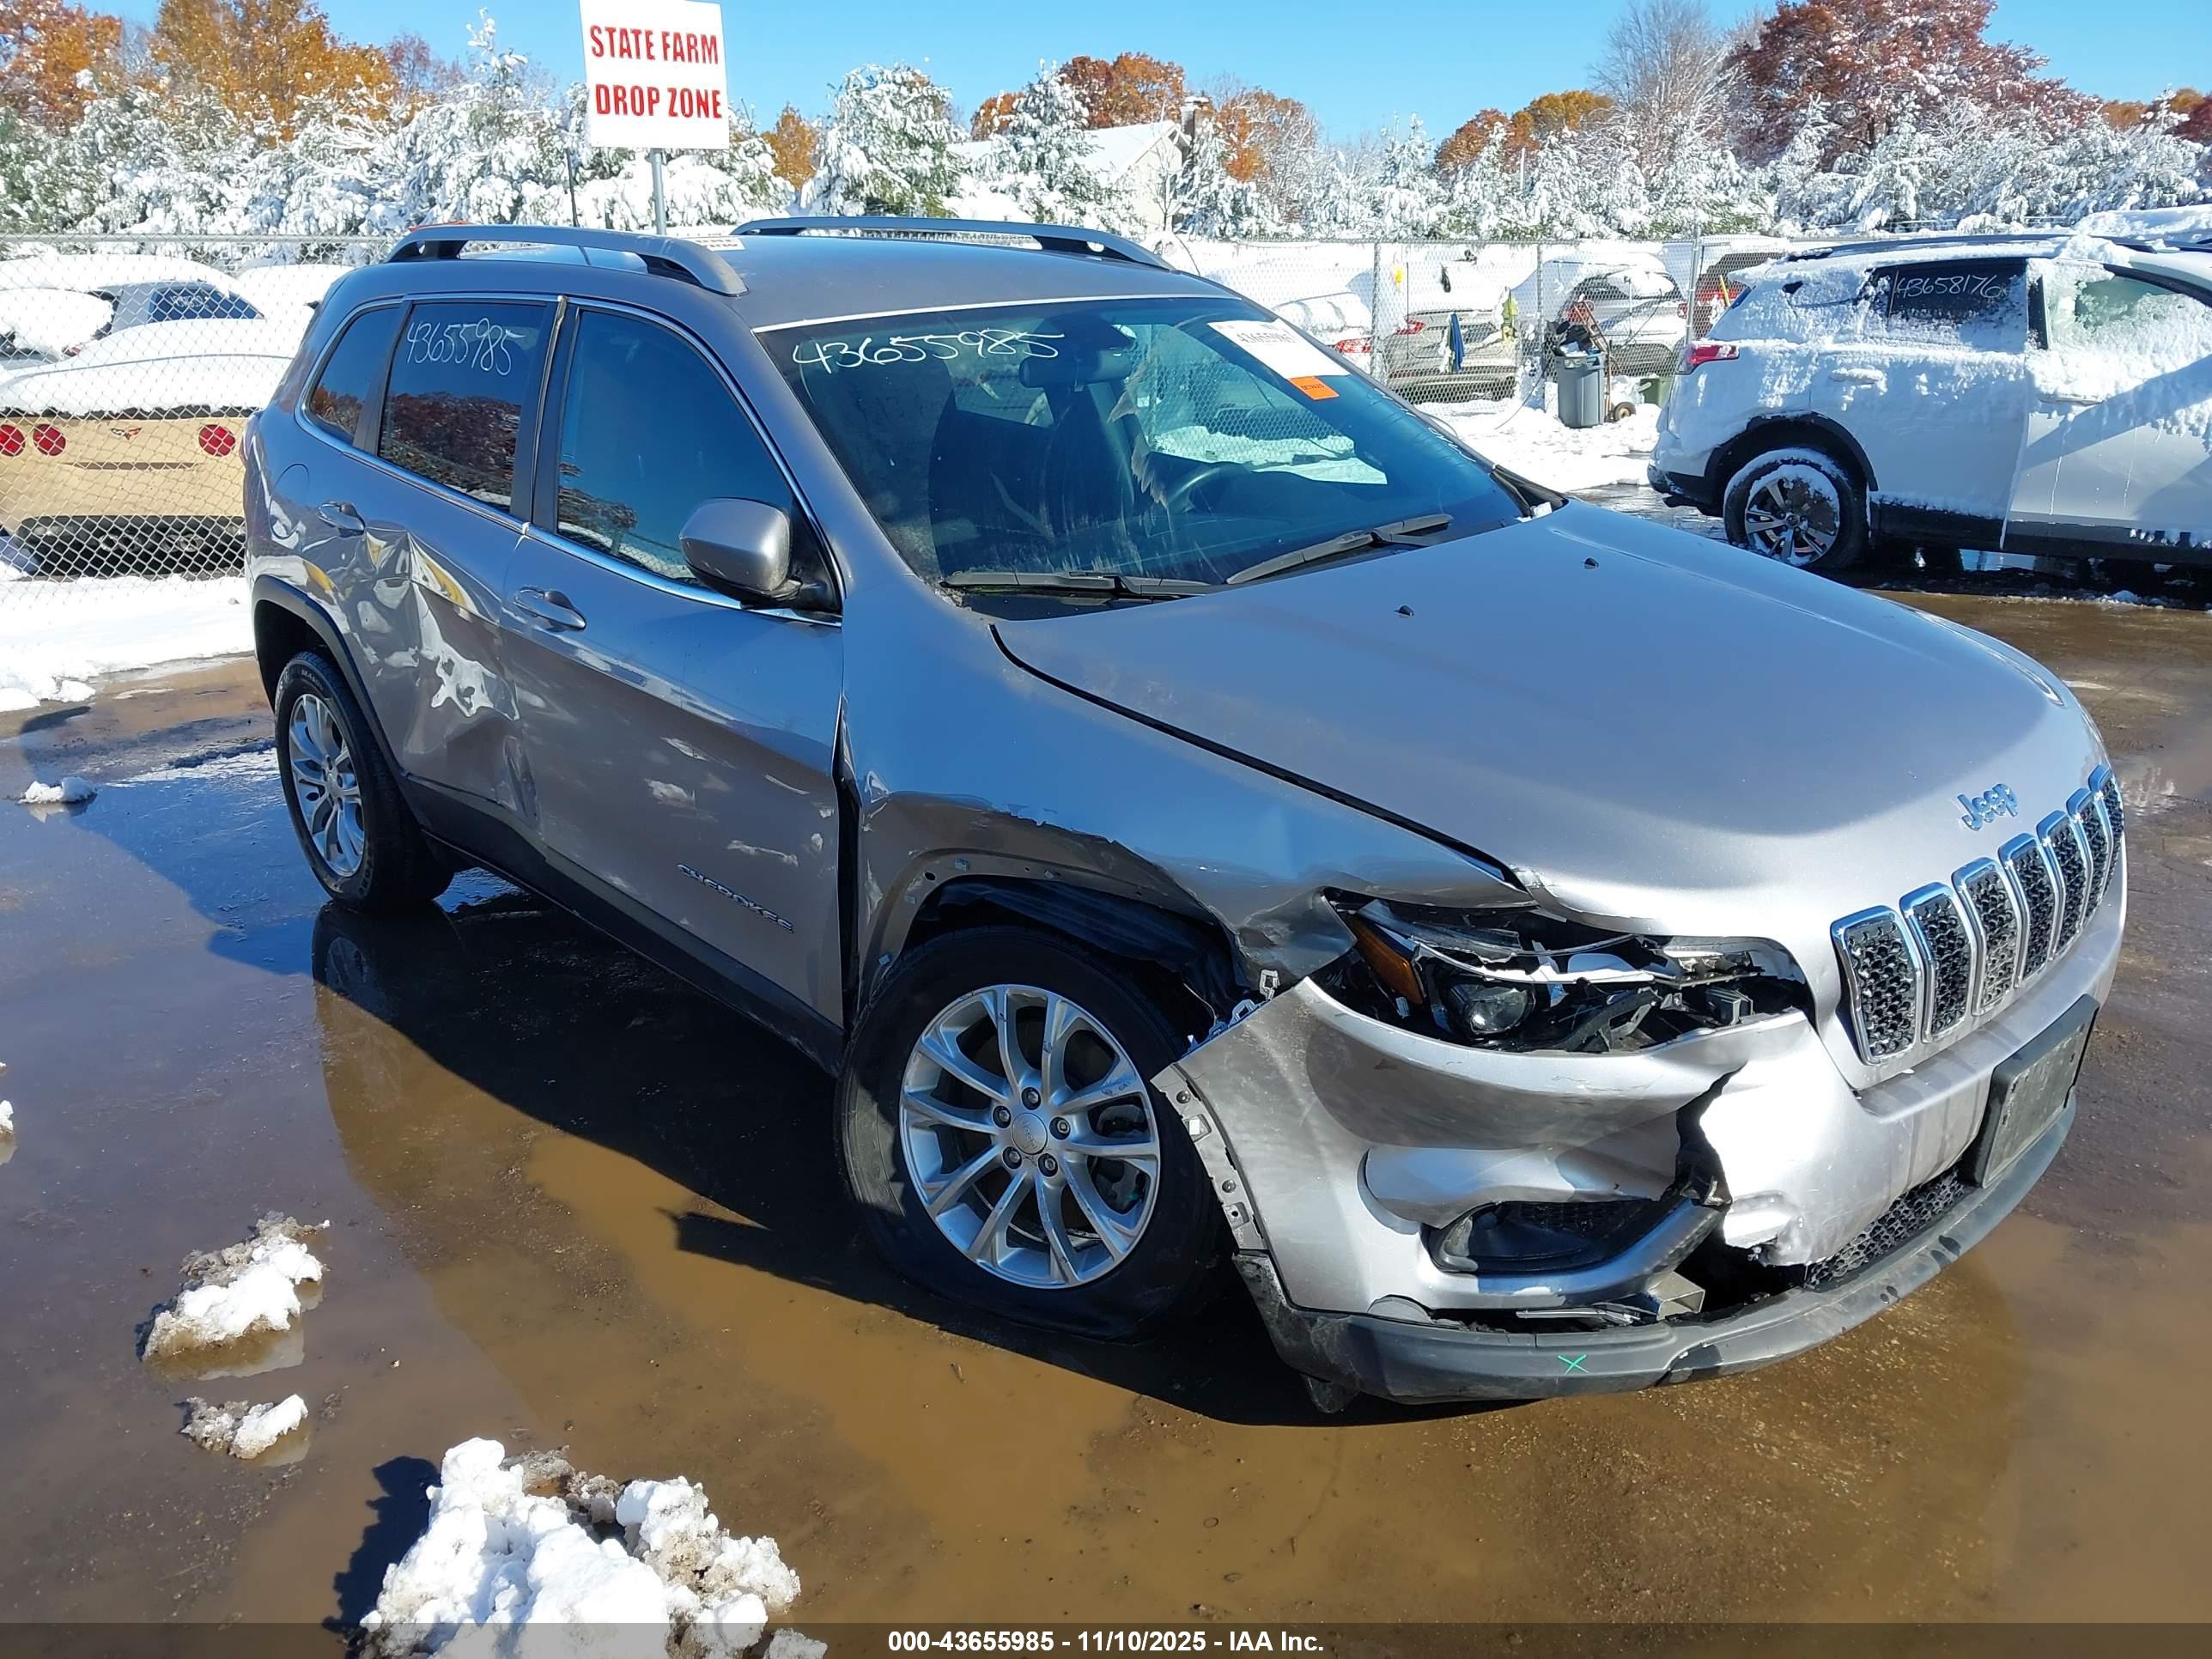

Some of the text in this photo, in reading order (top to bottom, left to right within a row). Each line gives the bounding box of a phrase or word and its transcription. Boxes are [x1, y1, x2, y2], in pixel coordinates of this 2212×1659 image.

[590, 25, 719, 64] STATE FARM
[595, 84, 722, 118] DROP ZONE
[1897, 274, 2002, 299] 43658176
[407, 318, 526, 375] 43655985
[792, 328, 1066, 374] 43655985
[1957, 783, 2018, 831] Jeep
